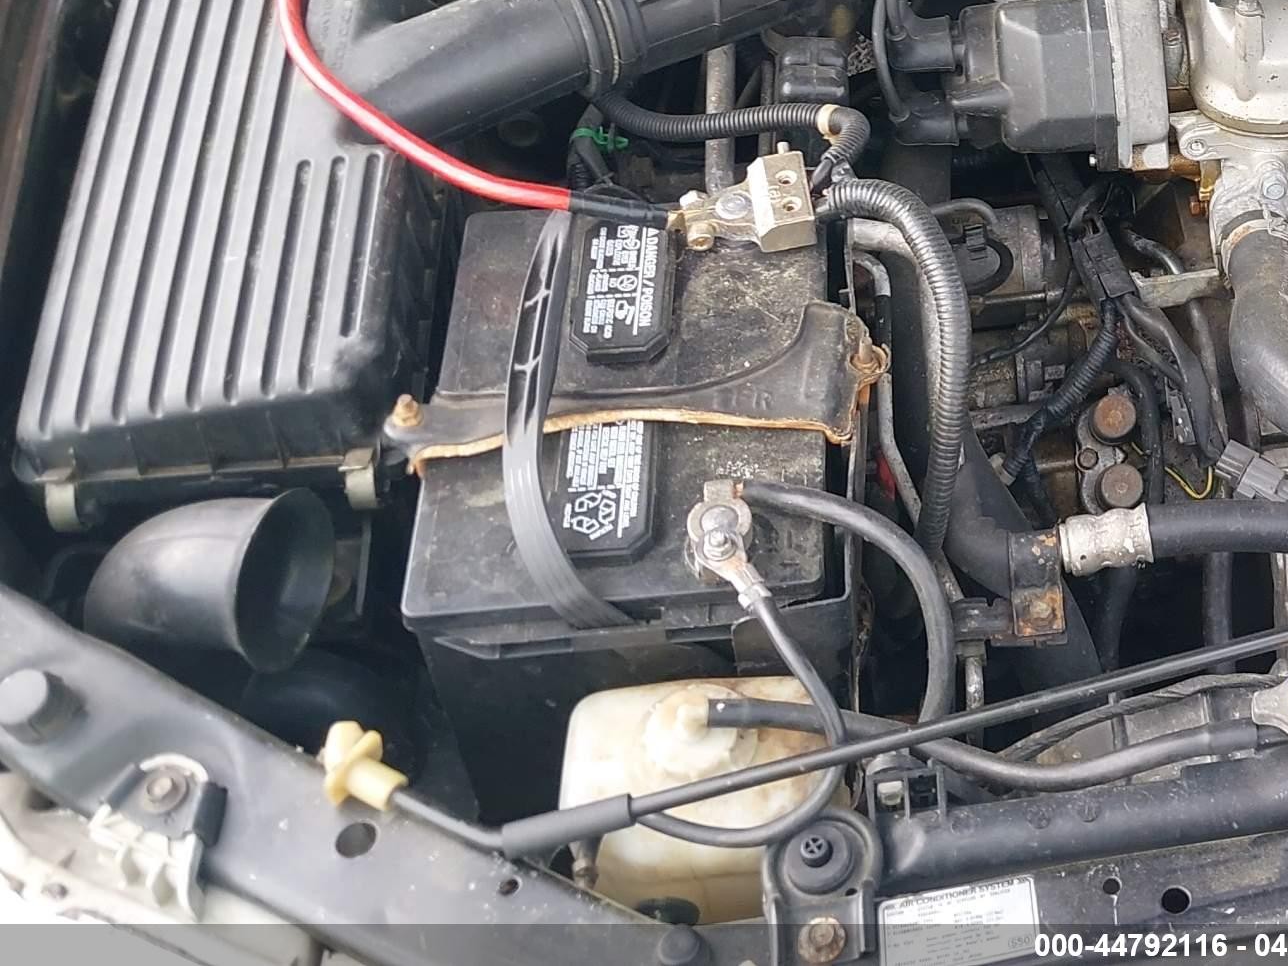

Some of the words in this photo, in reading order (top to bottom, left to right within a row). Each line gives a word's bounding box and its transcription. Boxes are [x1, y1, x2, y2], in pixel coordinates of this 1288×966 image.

[645, 237, 659, 279] DANGER
[640, 287, 655, 327] POISON
[899, 898, 916, 908] AIR
[915, 883, 977, 906] CONDITIONER
[978, 879, 1015, 894] SYSTEM
